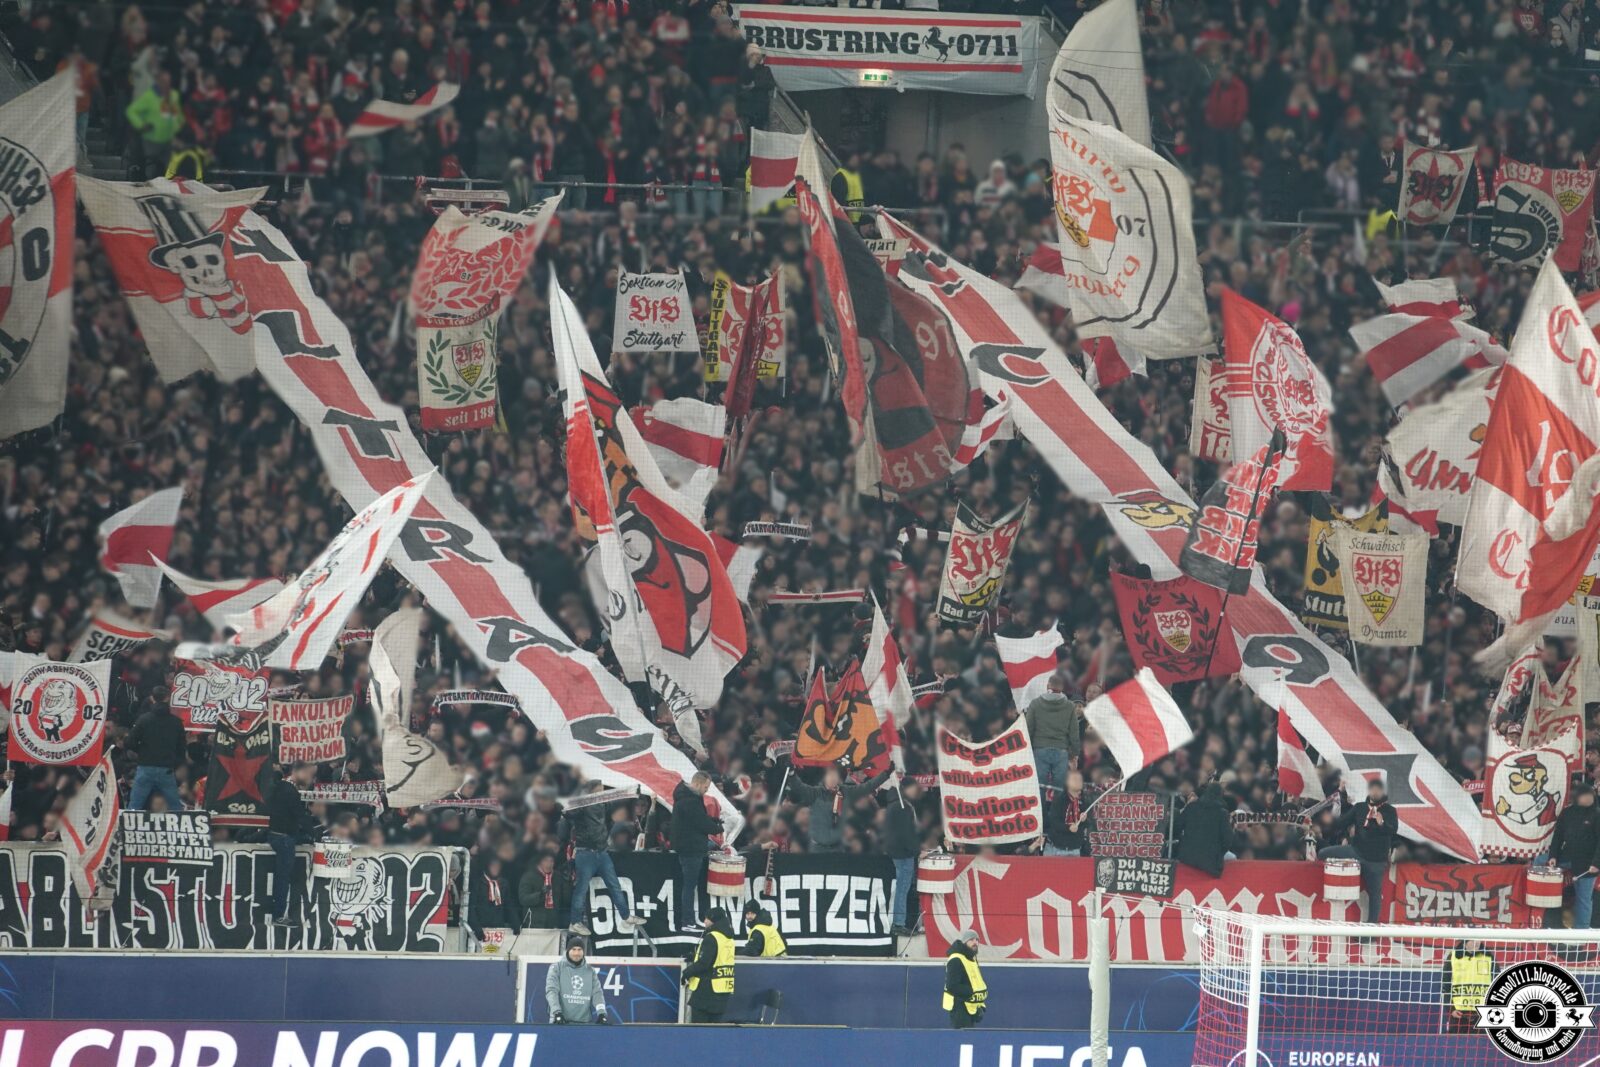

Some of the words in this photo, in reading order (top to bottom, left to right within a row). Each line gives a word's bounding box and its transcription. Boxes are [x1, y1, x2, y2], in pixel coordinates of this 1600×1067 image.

[745, 25, 920, 54] BRUSTRING
[956, 34, 1018, 56] 0711
[1500, 162, 1544, 184] 1893
[1116, 214, 1147, 238] 07
[619, 273, 665, 295] Sektion
[629, 295, 681, 324] VfB
[705, 279, 728, 374] STUTTGART
[623, 328, 687, 350] Stuttgart
[445, 410, 469, 427] seit
[1349, 537, 1406, 552] Schwäbisch
[1355, 556, 1401, 587] VfB
[943, 603, 963, 617] Bad
[23, 665, 99, 691] SCHWABENSTURM
[13, 698, 33, 715] 20
[83, 705, 104, 721] 02
[272, 696, 353, 722] FANKULTUR
[282, 720, 343, 743] BRAUCHT
[17, 727, 44, 757] ULTRAS
[43, 733, 94, 760] STUTTGART
[279, 741, 345, 763] FREIRAUM
[942, 732, 1024, 763] Gegen
[945, 797, 1036, 818] Stadion-
[1100, 793, 1157, 805] JEDER
[123, 813, 210, 834] ULTRAS
[949, 816, 1036, 838] verbote
[1097, 820, 1158, 832] KEHRT
[124, 831, 211, 847] BEDEUTET
[124, 844, 214, 861] WIDERSTAND
[1117, 858, 1136, 869] DU
[1141, 859, 1171, 874] BIST
[1117, 870, 1169, 886] IMMER
[1141, 885, 1169, 896] UNS!
[1405, 881, 1490, 919] SZENE
[1497, 885, 1513, 924] E
[1289, 1051, 1380, 1067] EUROPEAN
